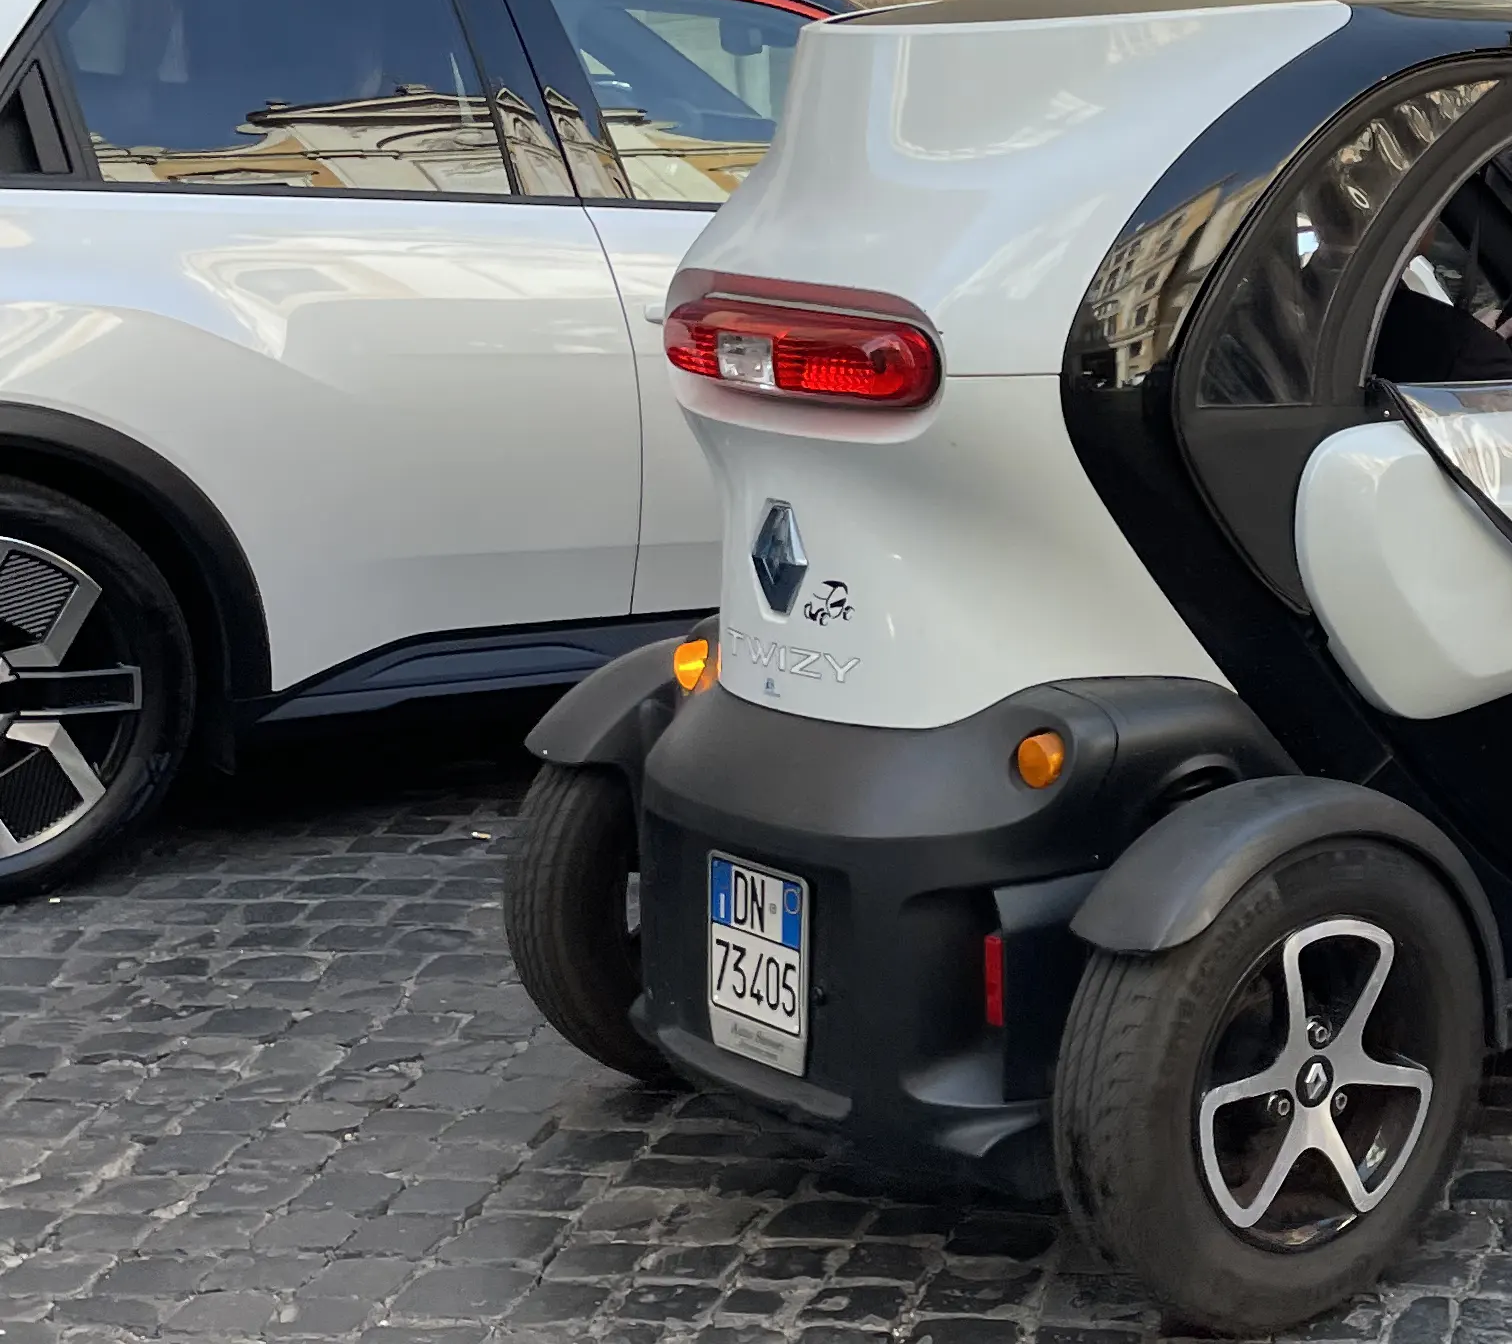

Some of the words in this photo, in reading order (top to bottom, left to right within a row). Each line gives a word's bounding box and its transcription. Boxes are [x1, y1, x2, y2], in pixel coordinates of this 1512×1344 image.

[727, 626, 861, 684] TWIZY
[733, 870, 765, 933] DN
[715, 938, 797, 1018] 73405
